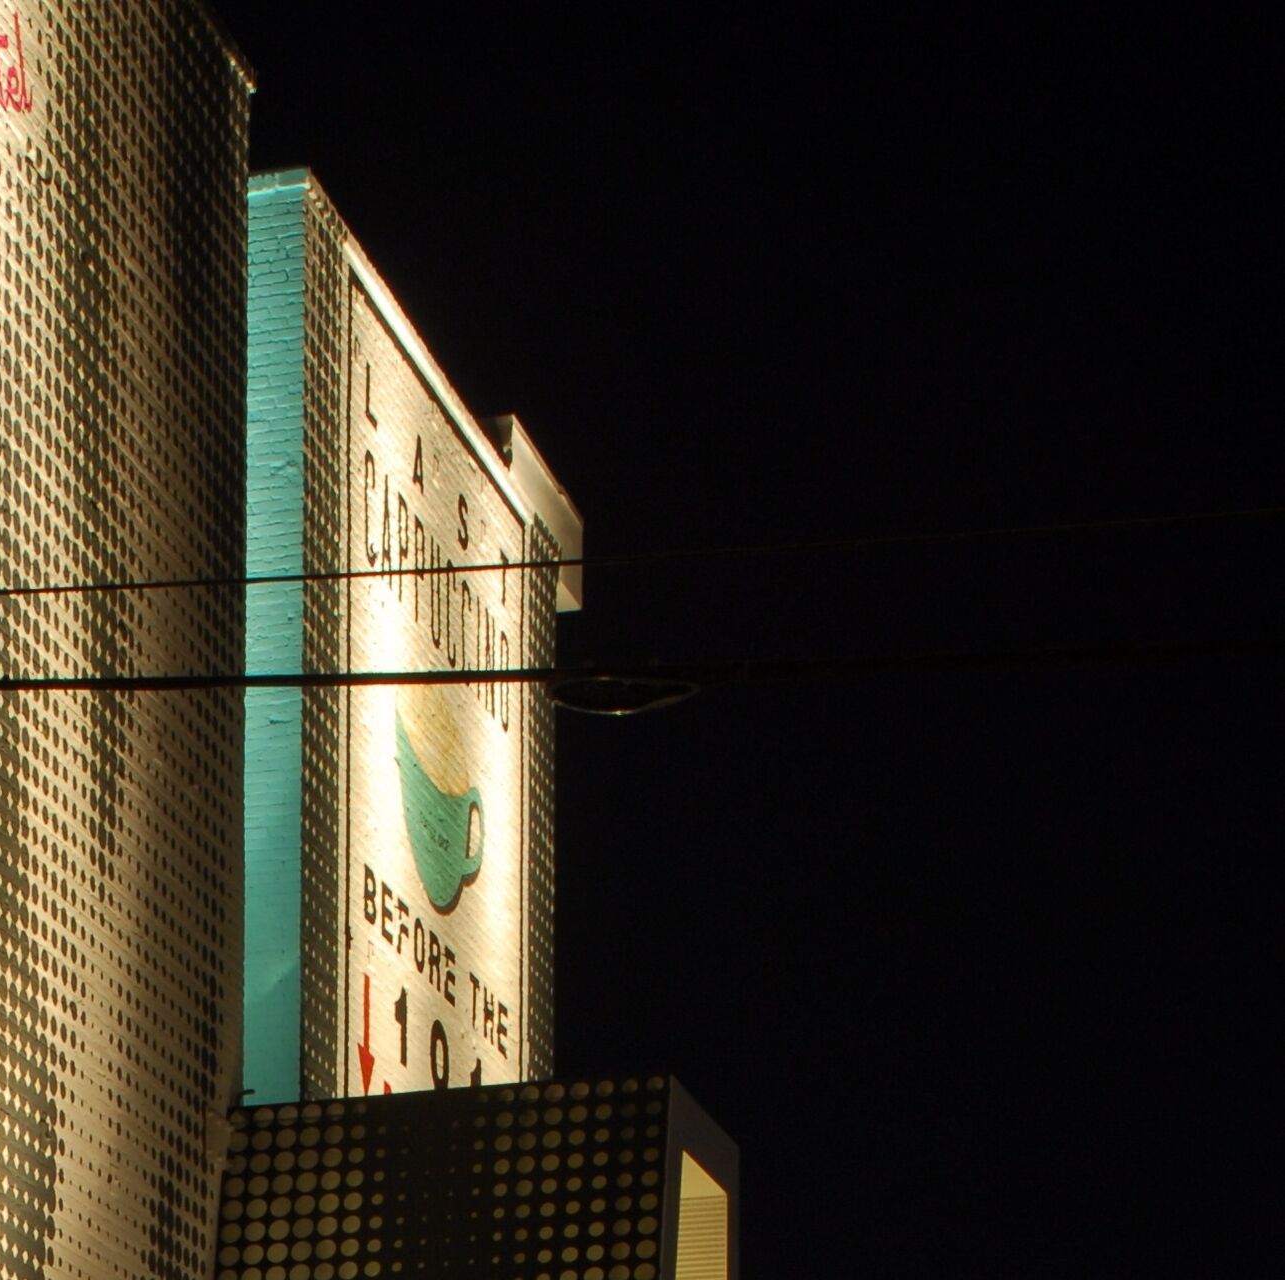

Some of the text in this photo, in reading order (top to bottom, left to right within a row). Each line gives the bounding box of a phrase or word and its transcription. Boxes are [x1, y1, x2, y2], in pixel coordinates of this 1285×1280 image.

[364, 449, 510, 734] CAPPUCCINO
[363, 863, 457, 1008] BEFORE
[469, 971, 509, 1060] THE
